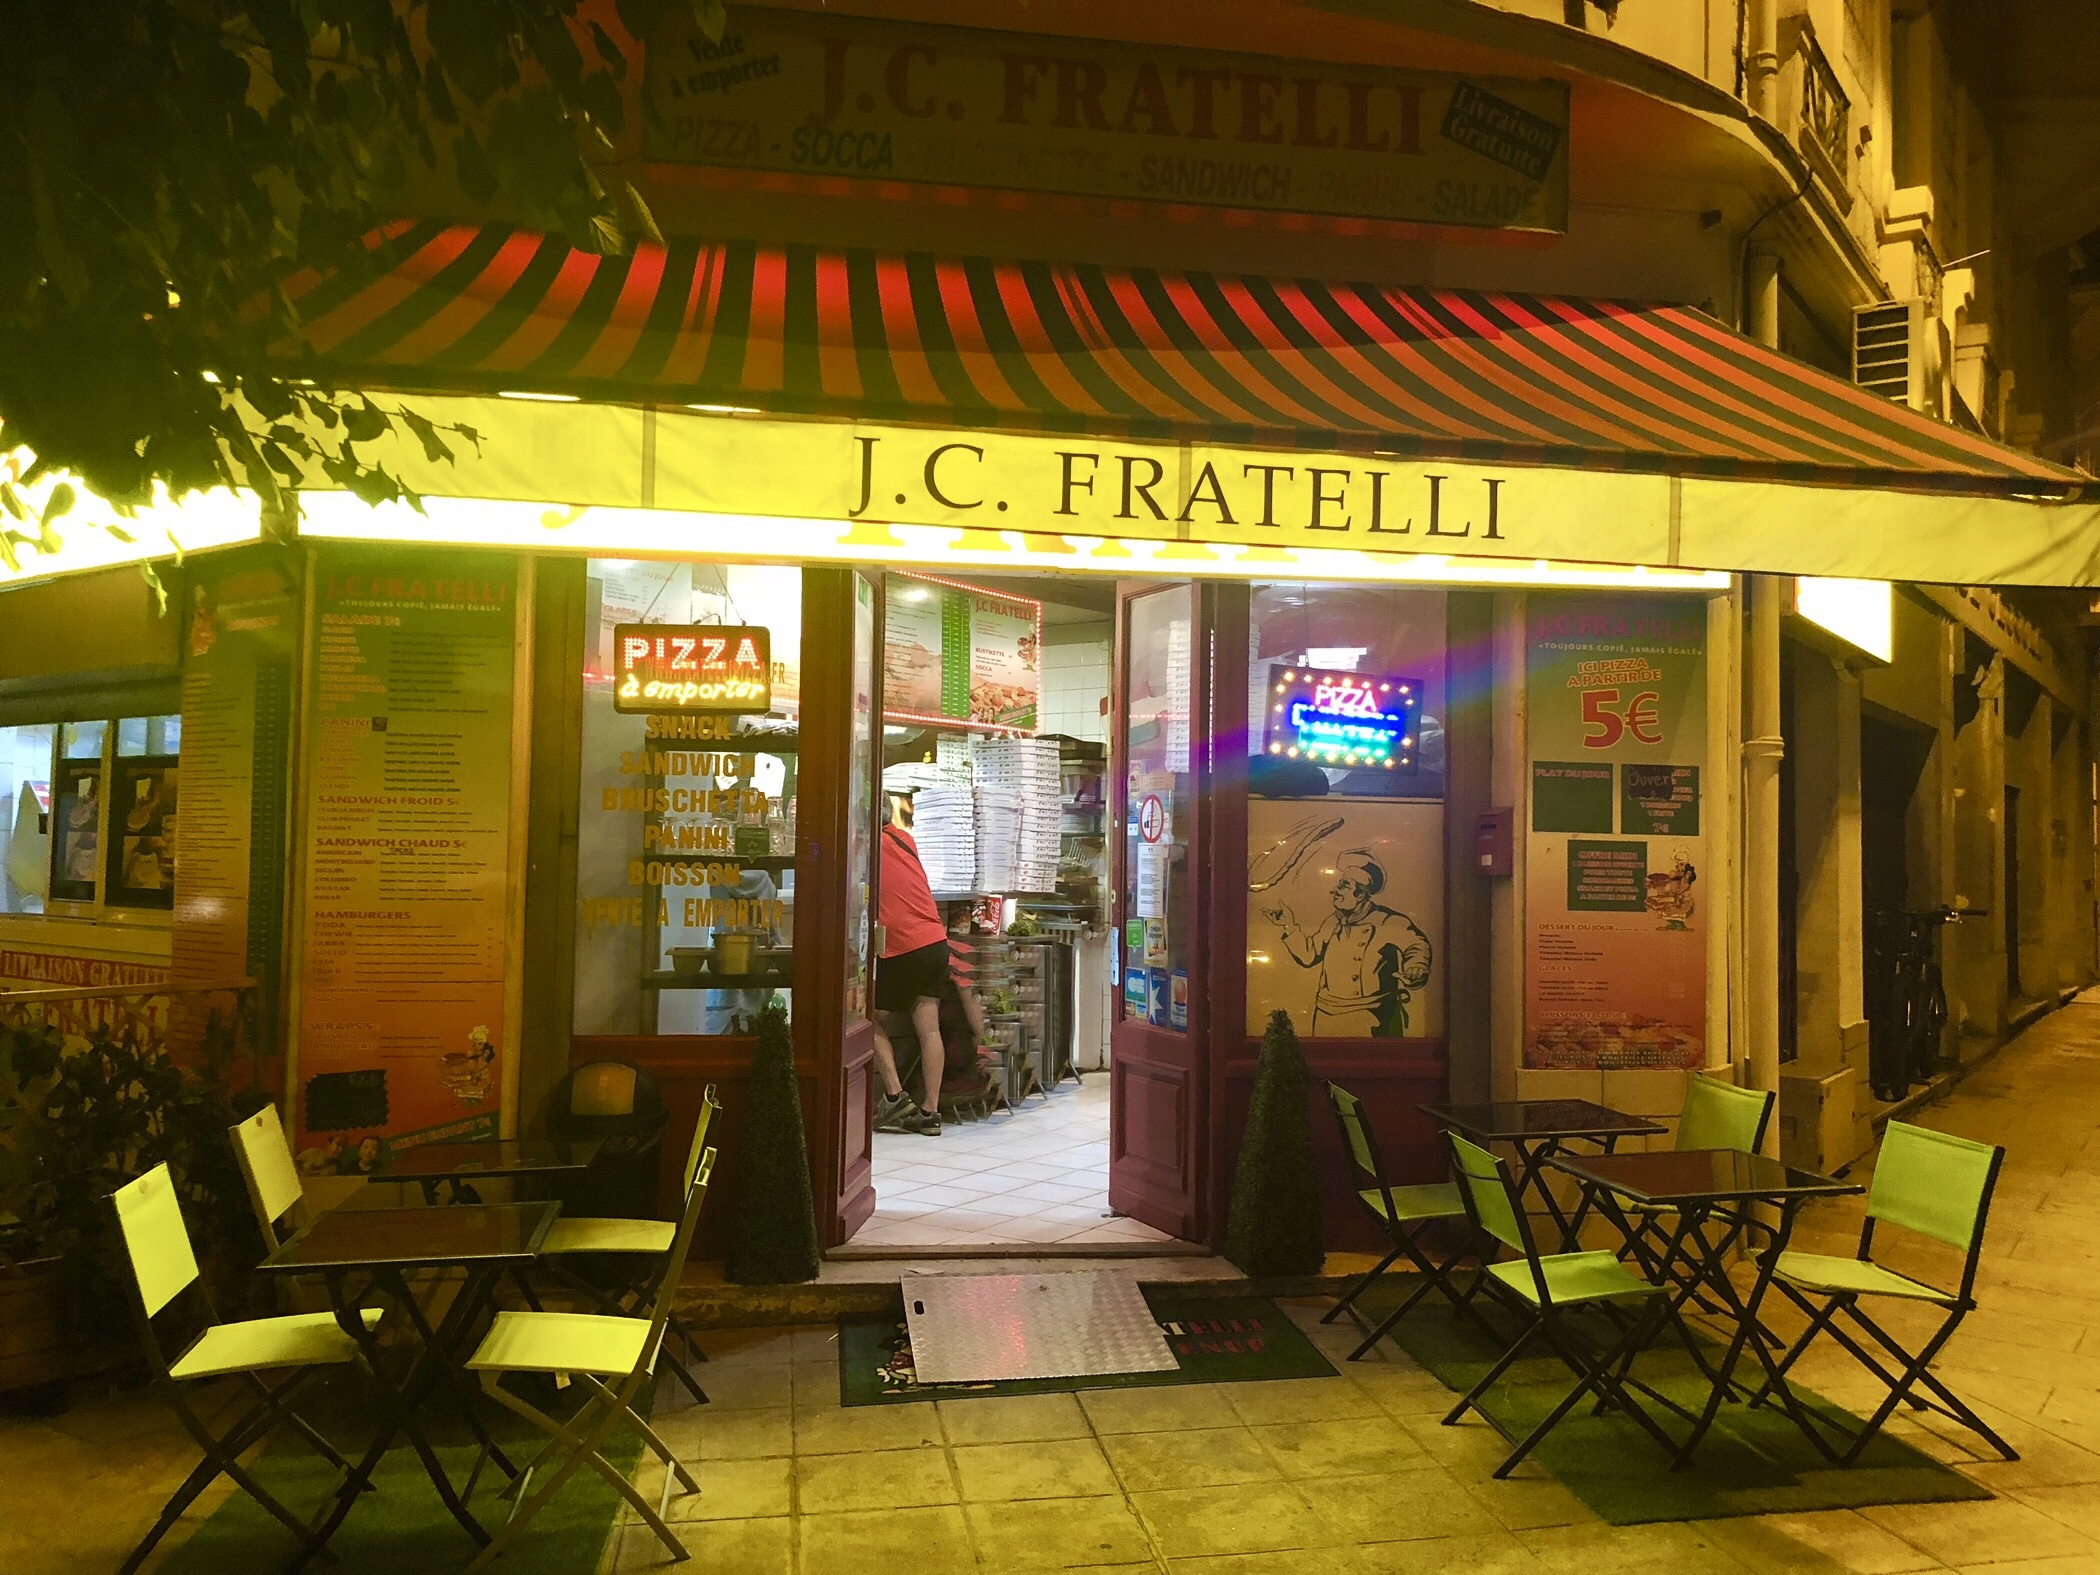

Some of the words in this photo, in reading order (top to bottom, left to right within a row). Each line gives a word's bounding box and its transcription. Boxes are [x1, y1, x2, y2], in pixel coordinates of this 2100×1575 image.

[807, 36, 963, 126] J.C.
[1000, 53, 1425, 157] FRATELLI
[1455, 84, 1556, 150] Livraison
[675, 114, 762, 157] PIZZA
[791, 124, 894, 170] SOCCA
[1137, 154, 1293, 203] SANDWICH
[847, 436, 1008, 518] J.C.
[1052, 451, 1507, 541] FRATELLI
[990, 601, 1032, 621] FRATELLI
[622, 636, 761, 671] PIZZA
[1577, 662, 1599, 674] ICI
[1600, 657, 1649, 673] PIZZA
[975, 664, 993, 672] SOCCA
[1567, 675, 1579, 688] A
[1583, 671, 1639, 687] PARTIR
[1640, 669, 1662, 681] DE
[618, 672, 641, 699] à
[642, 680, 765, 706] emporter
[1315, 684, 1377, 713] PIZZA
[644, 715, 732, 740] SNACK
[1580, 688, 1663, 750] 5€
[619, 751, 756, 777] SANDWICH
[317, 795, 397, 805] SANDWICH
[399, 797, 444, 806] FROID
[601, 787, 770, 814] BRUSCHETTA
[315, 838, 396, 848] SANDWICH
[398, 839, 450, 848] CHAUD
[644, 824, 731, 849] PANINI
[1578, 851, 1611, 860] OFFRE
[627, 861, 741, 887] BOISSON
[314, 910, 411, 919] HAMBURGERS
[657, 897, 670, 928] A
[683, 897, 786, 928] EMPORTER
[1539, 923, 1576, 932] DESSERT
[1577, 924, 1591, 932] DU
[1591, 924, 1614, 933] JOUR
[1539, 964, 1573, 972] GLACES
[1539, 1011, 1584, 1020] BOISSONS
